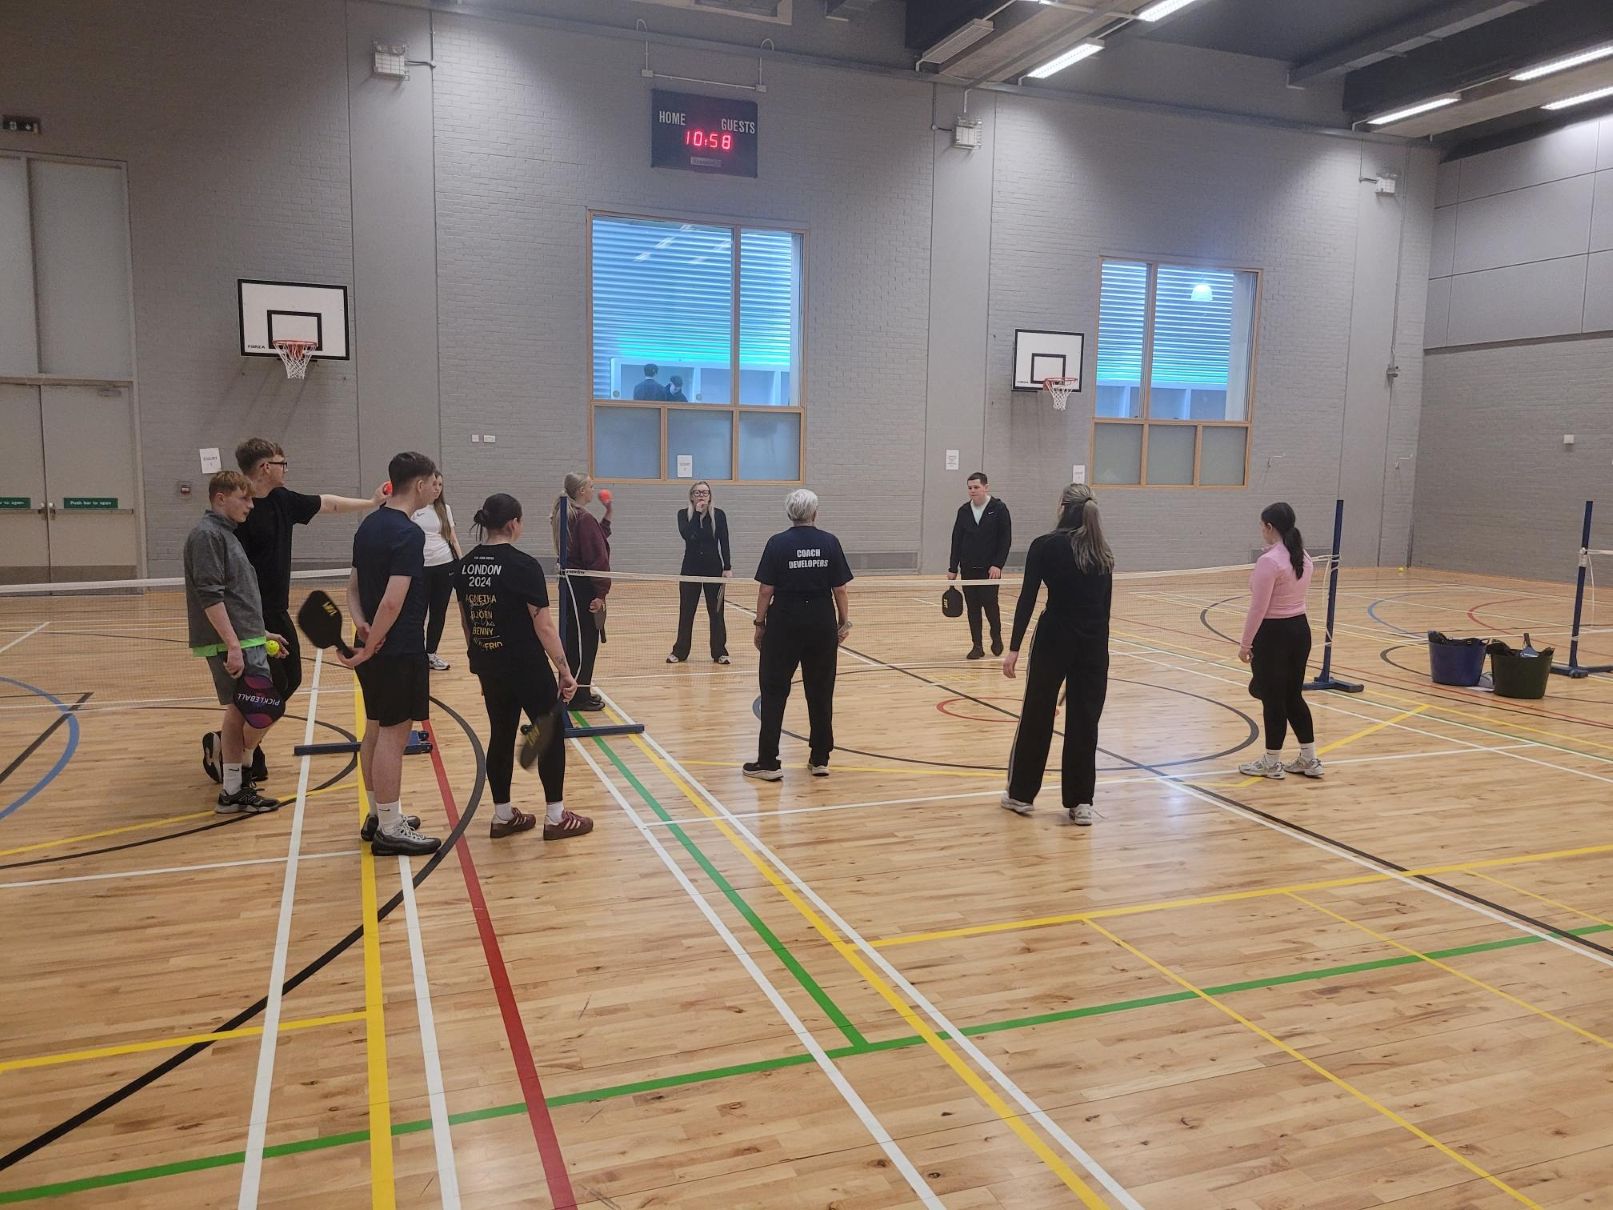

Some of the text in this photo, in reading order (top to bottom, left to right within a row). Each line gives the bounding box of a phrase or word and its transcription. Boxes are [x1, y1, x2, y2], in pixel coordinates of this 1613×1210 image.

[659, 111, 686, 125] HOME
[722, 119, 755, 134] GUESTS
[686, 131, 731, 149] 10:58
[797, 549, 820, 557] COACH
[462, 564, 501, 575] LONDON
[789, 560, 828, 568] DEVELOPERS
[469, 577, 491, 587] 2024
[238, 694, 280, 705] PICKLEBALL
